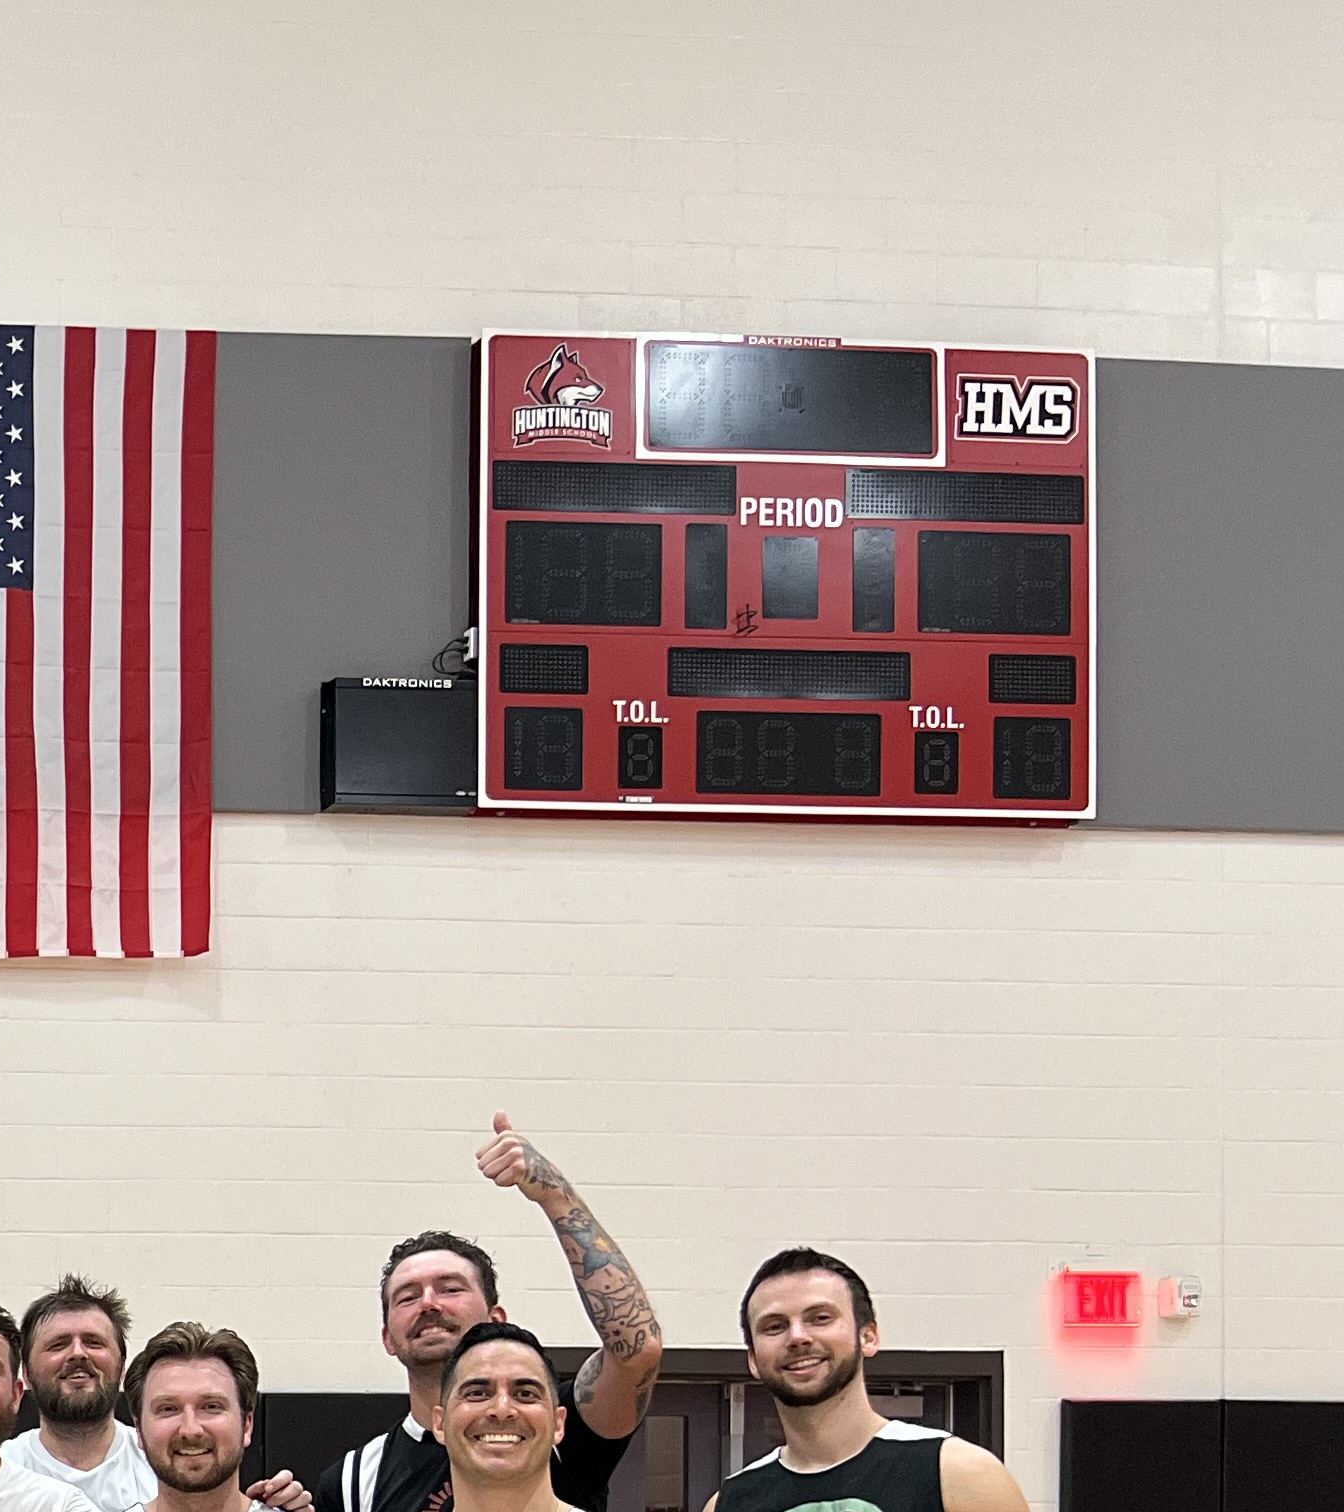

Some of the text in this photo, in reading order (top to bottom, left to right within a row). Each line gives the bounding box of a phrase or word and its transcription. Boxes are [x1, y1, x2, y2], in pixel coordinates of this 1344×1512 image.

[748, 336, 837, 348] DAKTRONICS
[962, 382, 1072, 435] HMS
[515, 407, 610, 436] HUNTINGTON
[528, 428, 597, 439] MIDDLE SCHOOL
[740, 496, 844, 528] PERIOD
[362, 677, 453, 689] DAKTRONICS
[612, 700, 669, 723] T.O.L.
[908, 705, 965, 729] T.O.L.
[1078, 1279, 1129, 1321] EXIT
